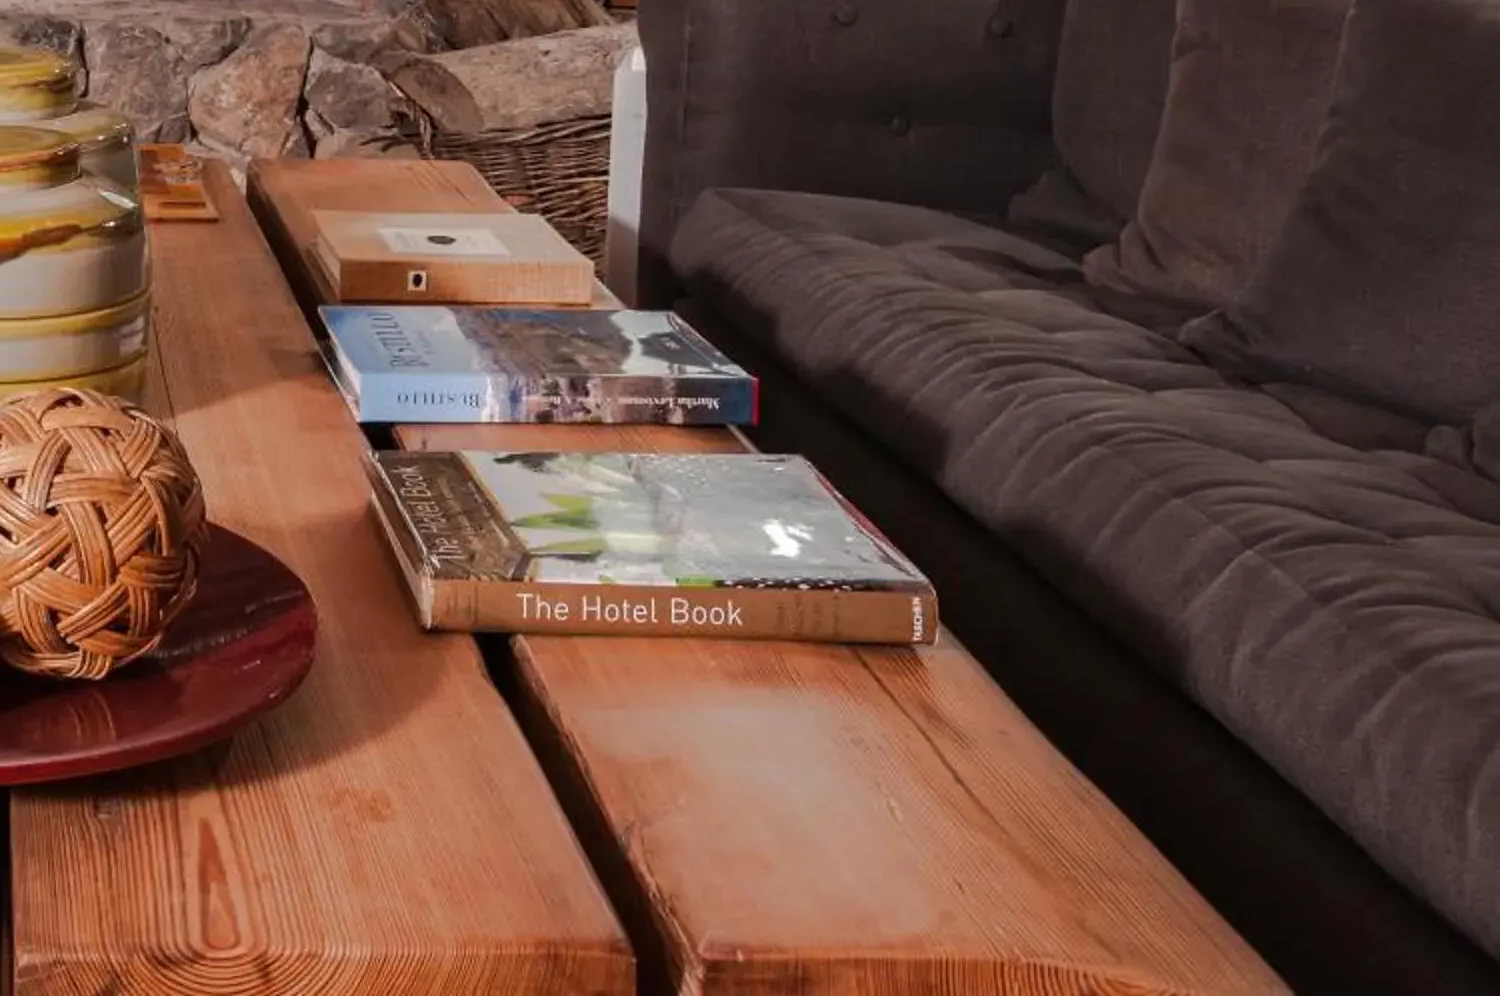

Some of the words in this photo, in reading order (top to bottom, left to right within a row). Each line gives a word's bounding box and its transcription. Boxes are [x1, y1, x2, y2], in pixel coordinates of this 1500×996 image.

[390, 466, 432, 497] Book
[407, 500, 453, 535] Hotel
[430, 536, 466, 566] The
[516, 593, 569, 621] The
[582, 595, 658, 623] Hotel
[671, 597, 743, 626] Book
